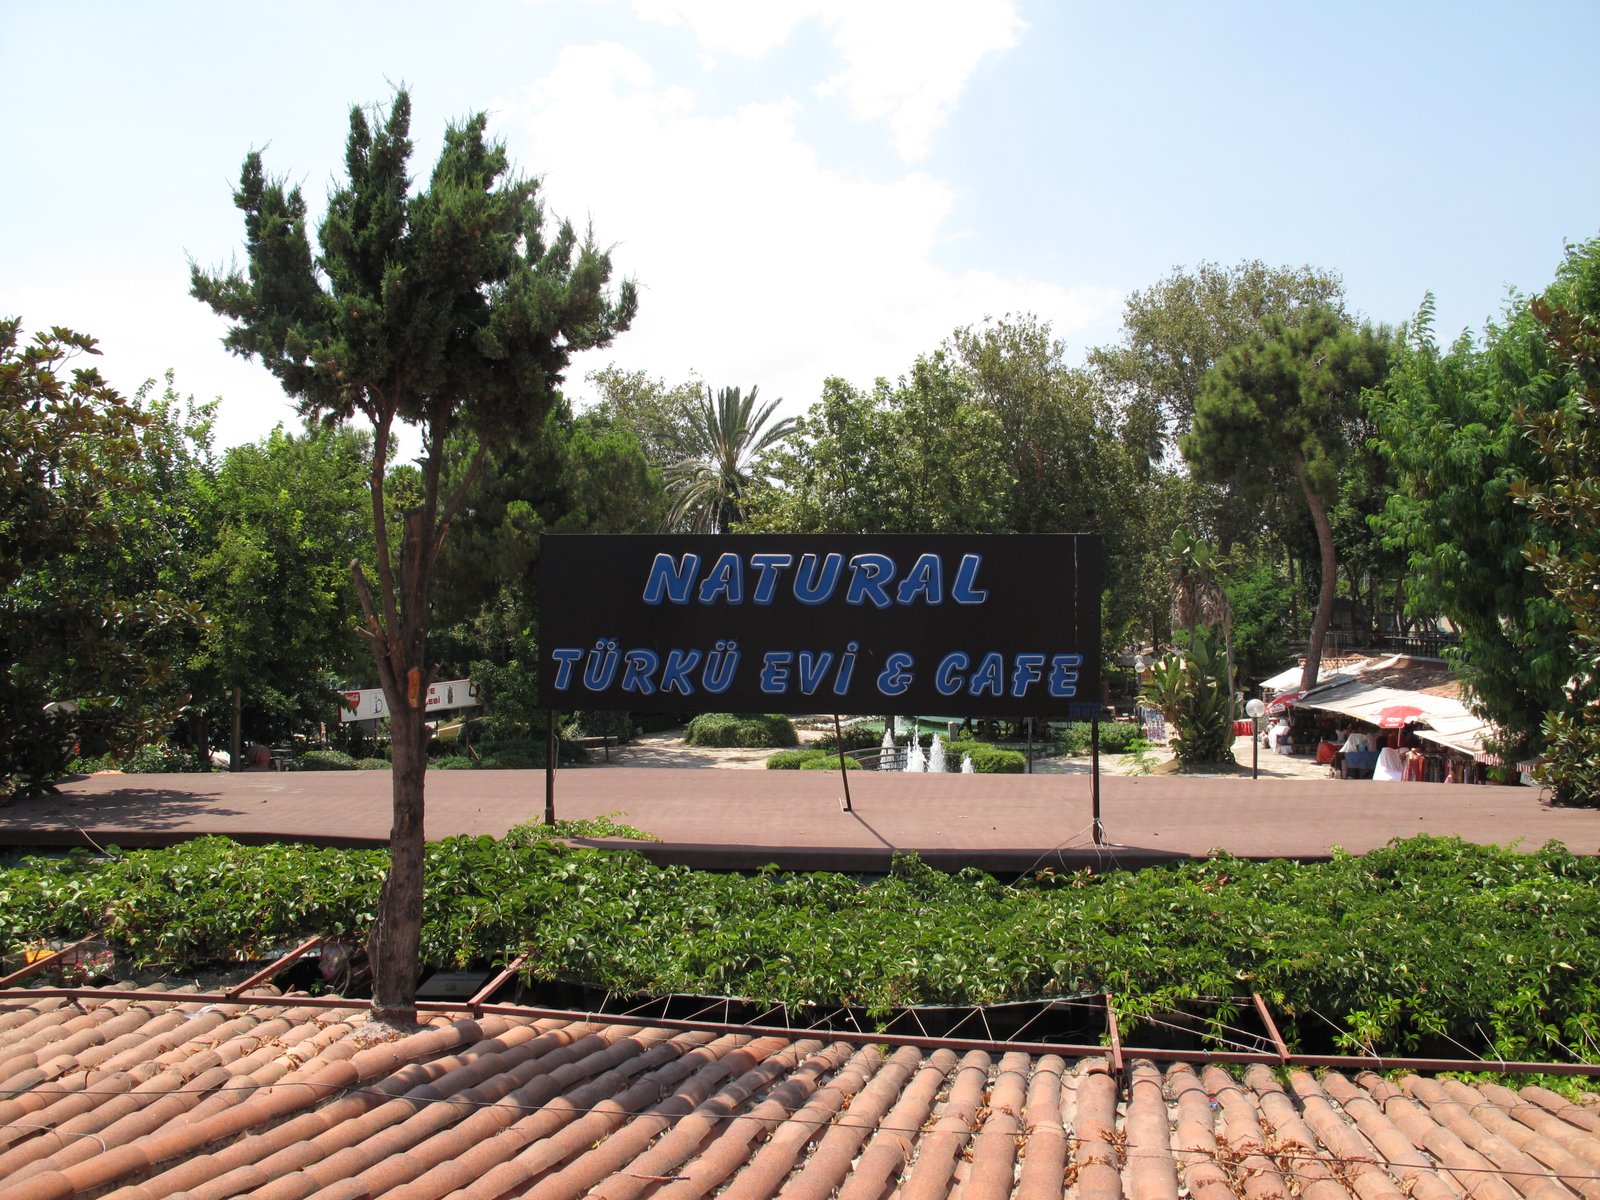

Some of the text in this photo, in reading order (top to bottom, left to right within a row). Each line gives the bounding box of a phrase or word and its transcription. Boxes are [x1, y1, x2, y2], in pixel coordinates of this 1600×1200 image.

[642, 552, 989, 608] NATURAL
[551, 637, 1086, 698] TÜRKÜ EVİ & CAFE
